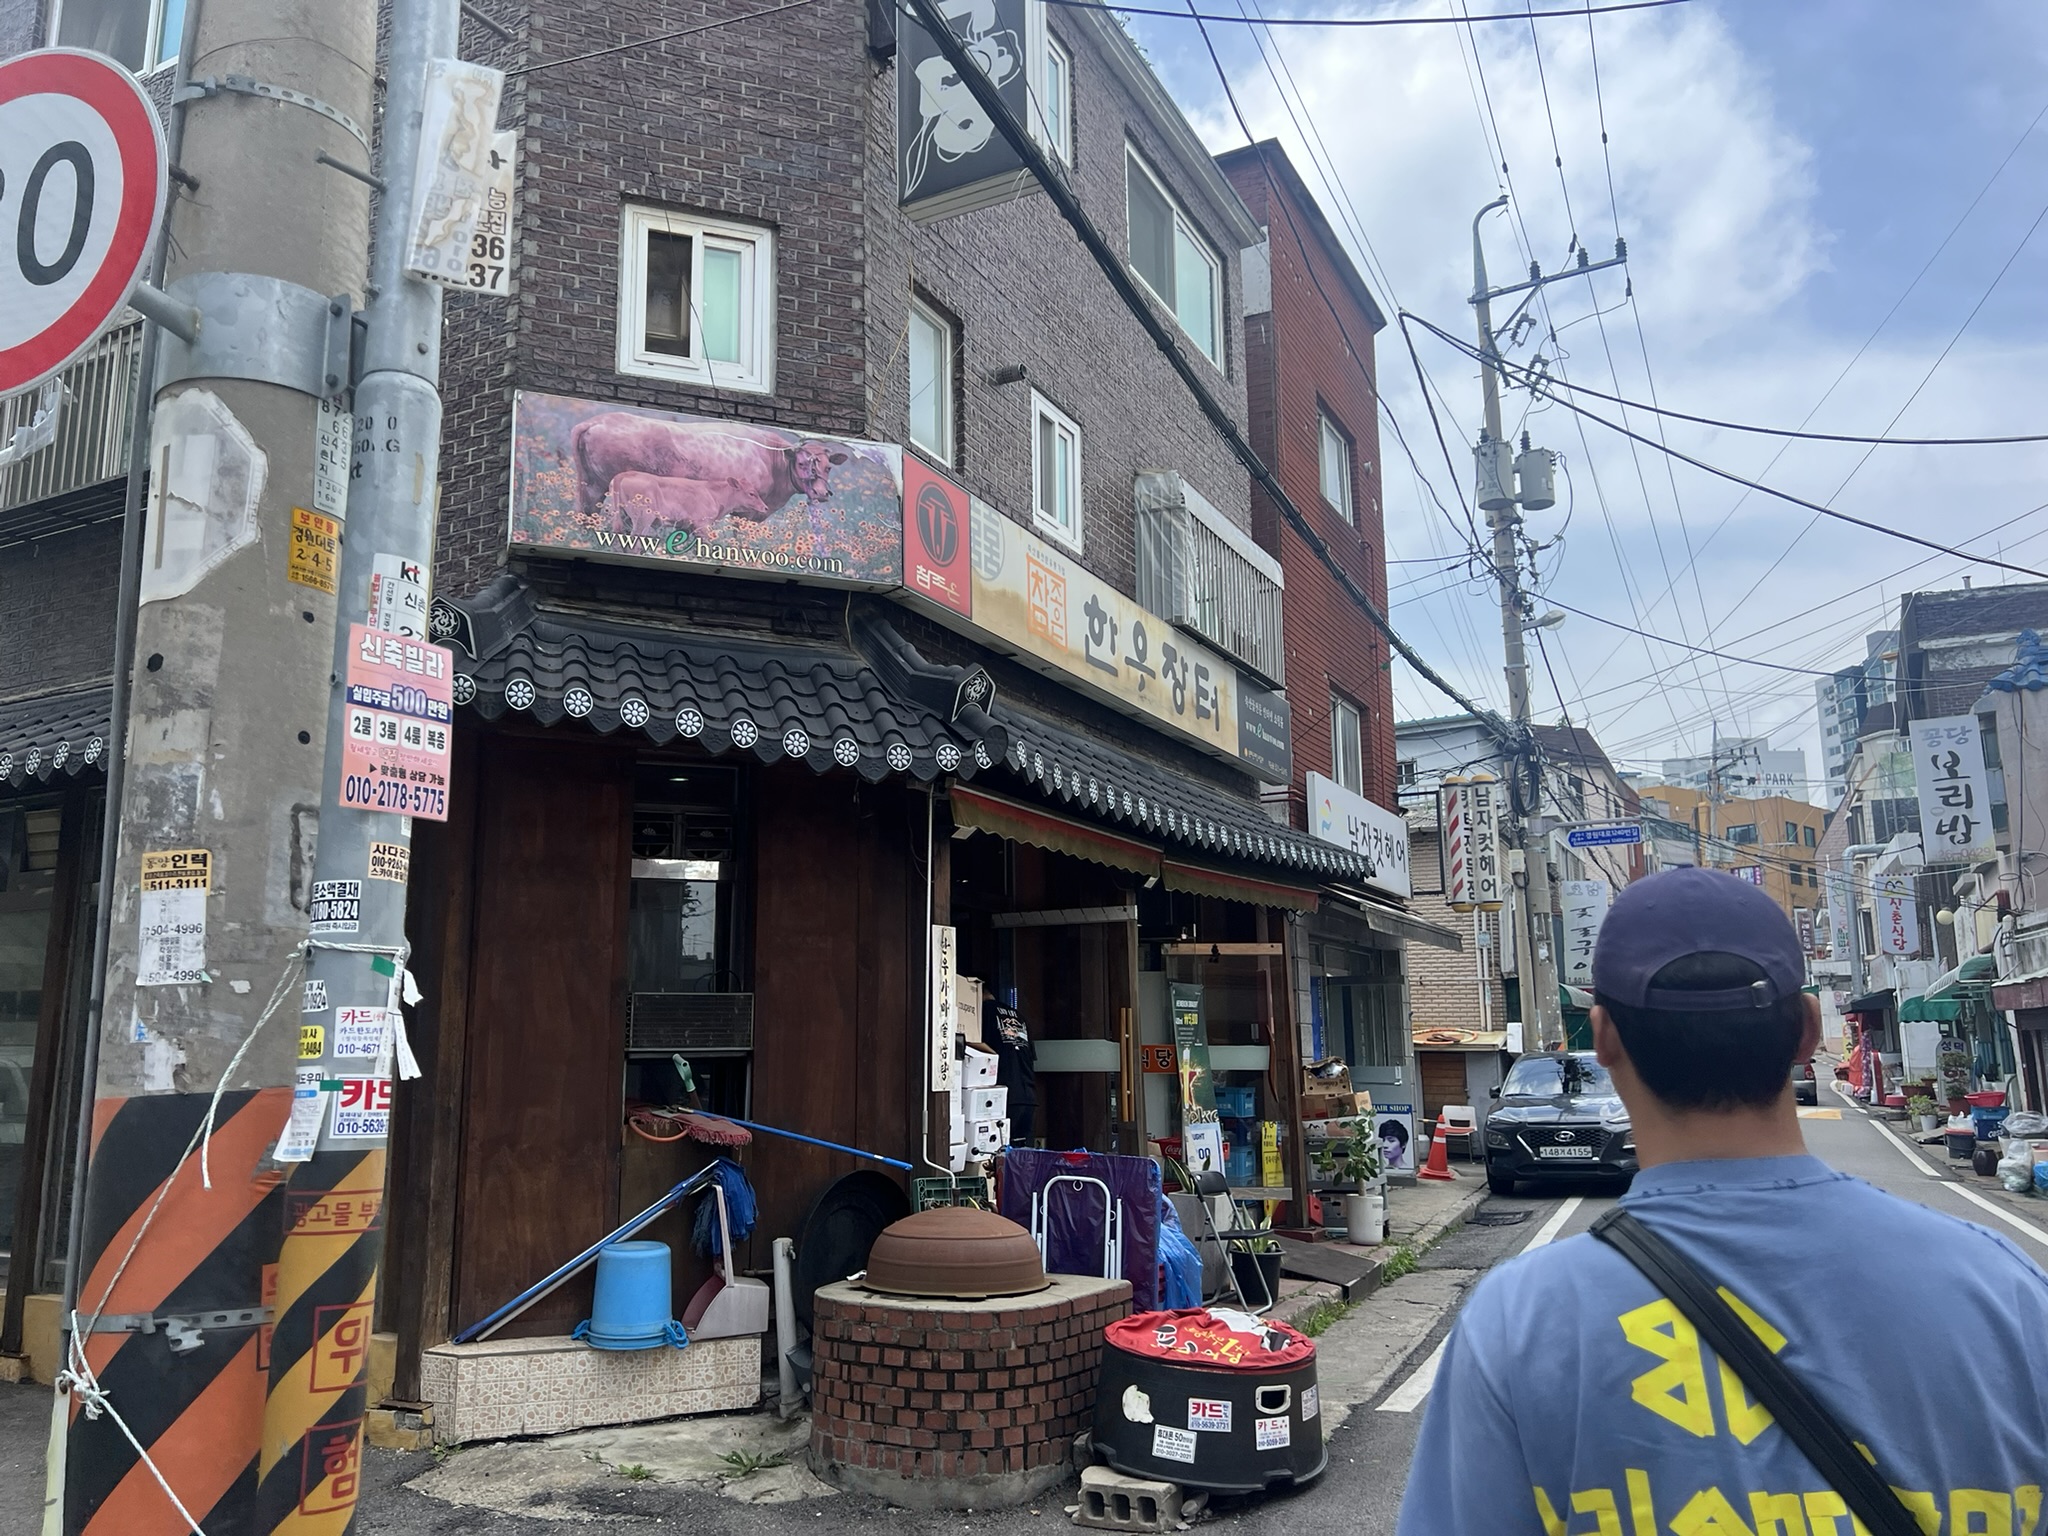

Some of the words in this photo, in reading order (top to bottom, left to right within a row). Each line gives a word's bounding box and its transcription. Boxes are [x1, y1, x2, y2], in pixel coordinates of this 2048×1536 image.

[0, 141, 95, 286] 0
[300, 511, 334, 535] 보안등
[595, 526, 845, 574] www.ehanwoo.com
[400, 561, 421, 584] kt
[404, 592, 426, 615] 신촌
[360, 632, 445, 680] 신축빌라
[1083, 594, 1220, 732] 한우장터
[354, 715, 372, 736] 2룸
[379, 720, 397, 741] 3룸
[404, 726, 421, 745] 4룸
[427, 728, 445, 750] 복층
[409, 769, 427, 783] 상담
[429, 772, 445, 786] 가능
[346, 774, 445, 816] 010-2178-5775
[1347, 813, 1407, 873] 남자컷헤어
[1475, 786, 1498, 900] 남자컷헤어
[1889, 897, 1908, 951] 신촌식당
[340, 1008, 373, 1026] 카드
[340, 1079, 392, 1111] 카드
[292, 1200, 354, 1228] 광고물
[1191, 1402, 1223, 1418] 카드
[1257, 1419, 1280, 1432] 카드
